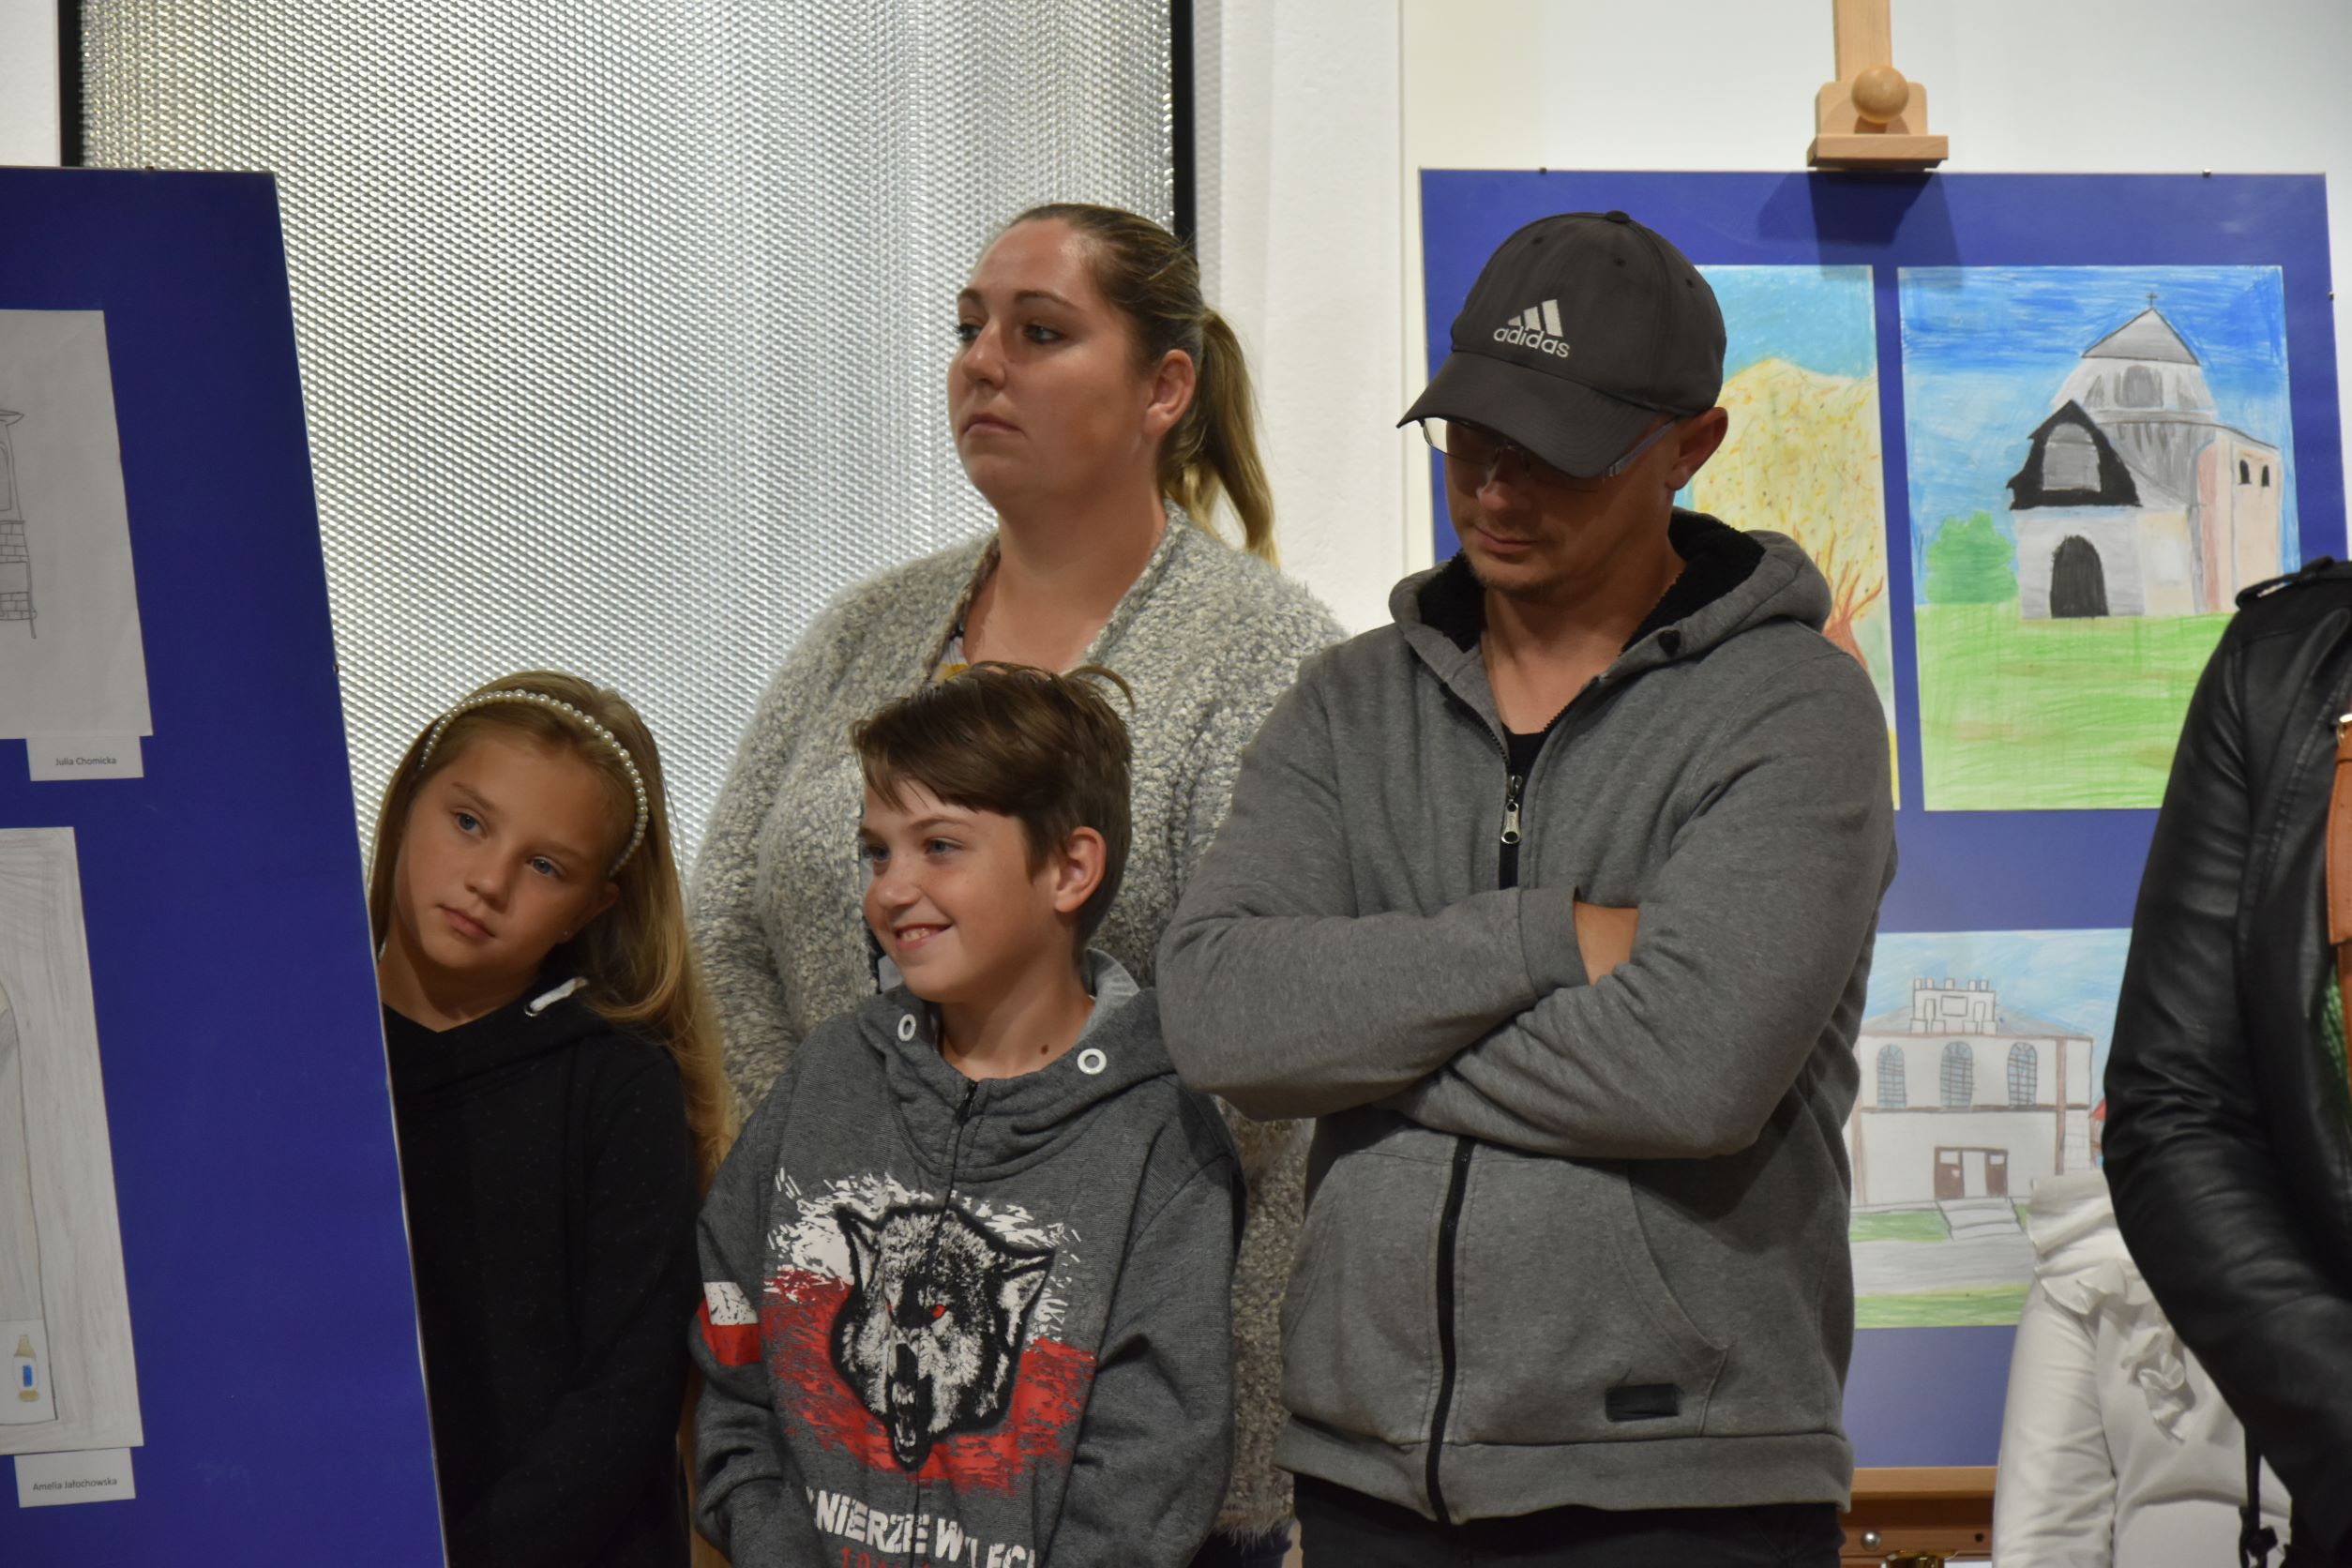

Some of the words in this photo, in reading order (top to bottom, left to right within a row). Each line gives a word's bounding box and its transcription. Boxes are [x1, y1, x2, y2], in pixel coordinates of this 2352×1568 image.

[1493, 325, 1571, 358] adidas
[55, 757, 73, 766] Julia
[32, 1481, 62, 1491] Amelia
